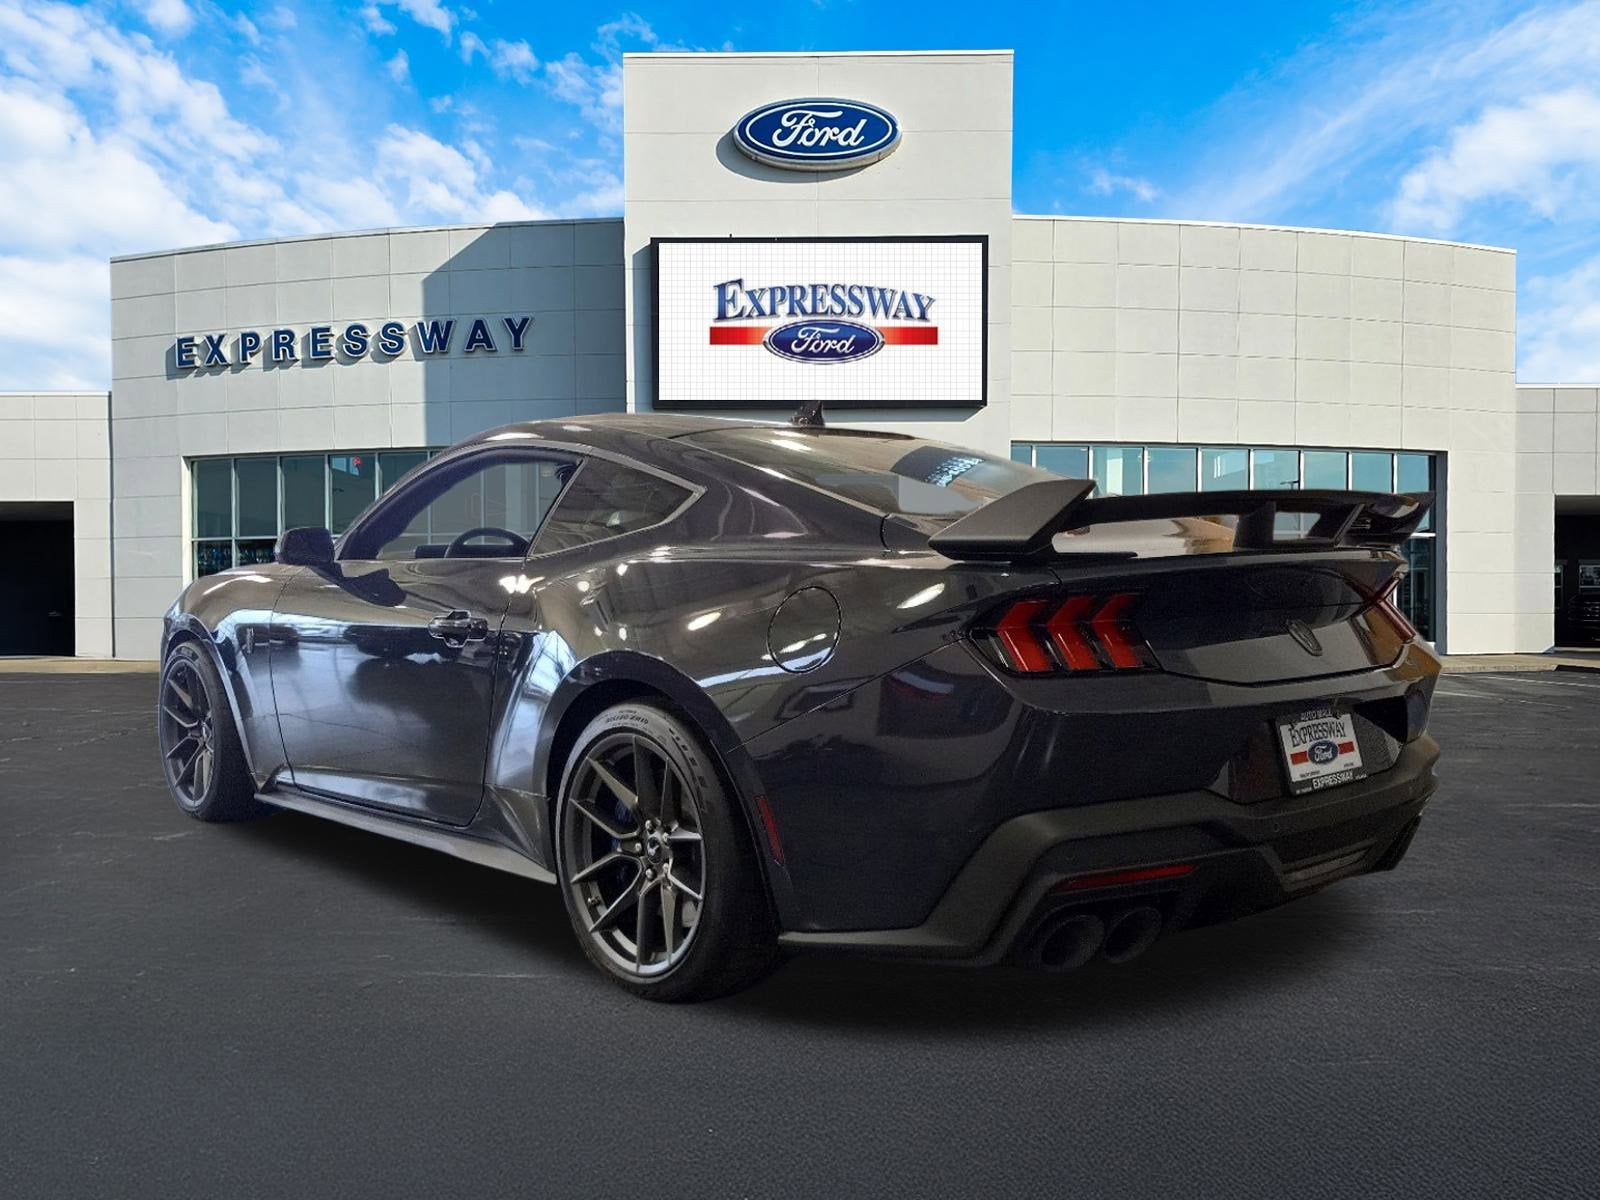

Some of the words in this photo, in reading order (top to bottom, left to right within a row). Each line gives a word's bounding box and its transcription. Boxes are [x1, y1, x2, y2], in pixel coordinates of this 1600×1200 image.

[772, 110, 867, 147] Ford
[712, 278, 935, 322] EXPRESSWAY
[175, 315, 532, 369] EXPRESSWAY
[791, 325, 855, 354] Ford
[1288, 721, 1347, 748] EXPRESSWAY
[1314, 745, 1333, 762] Ford
